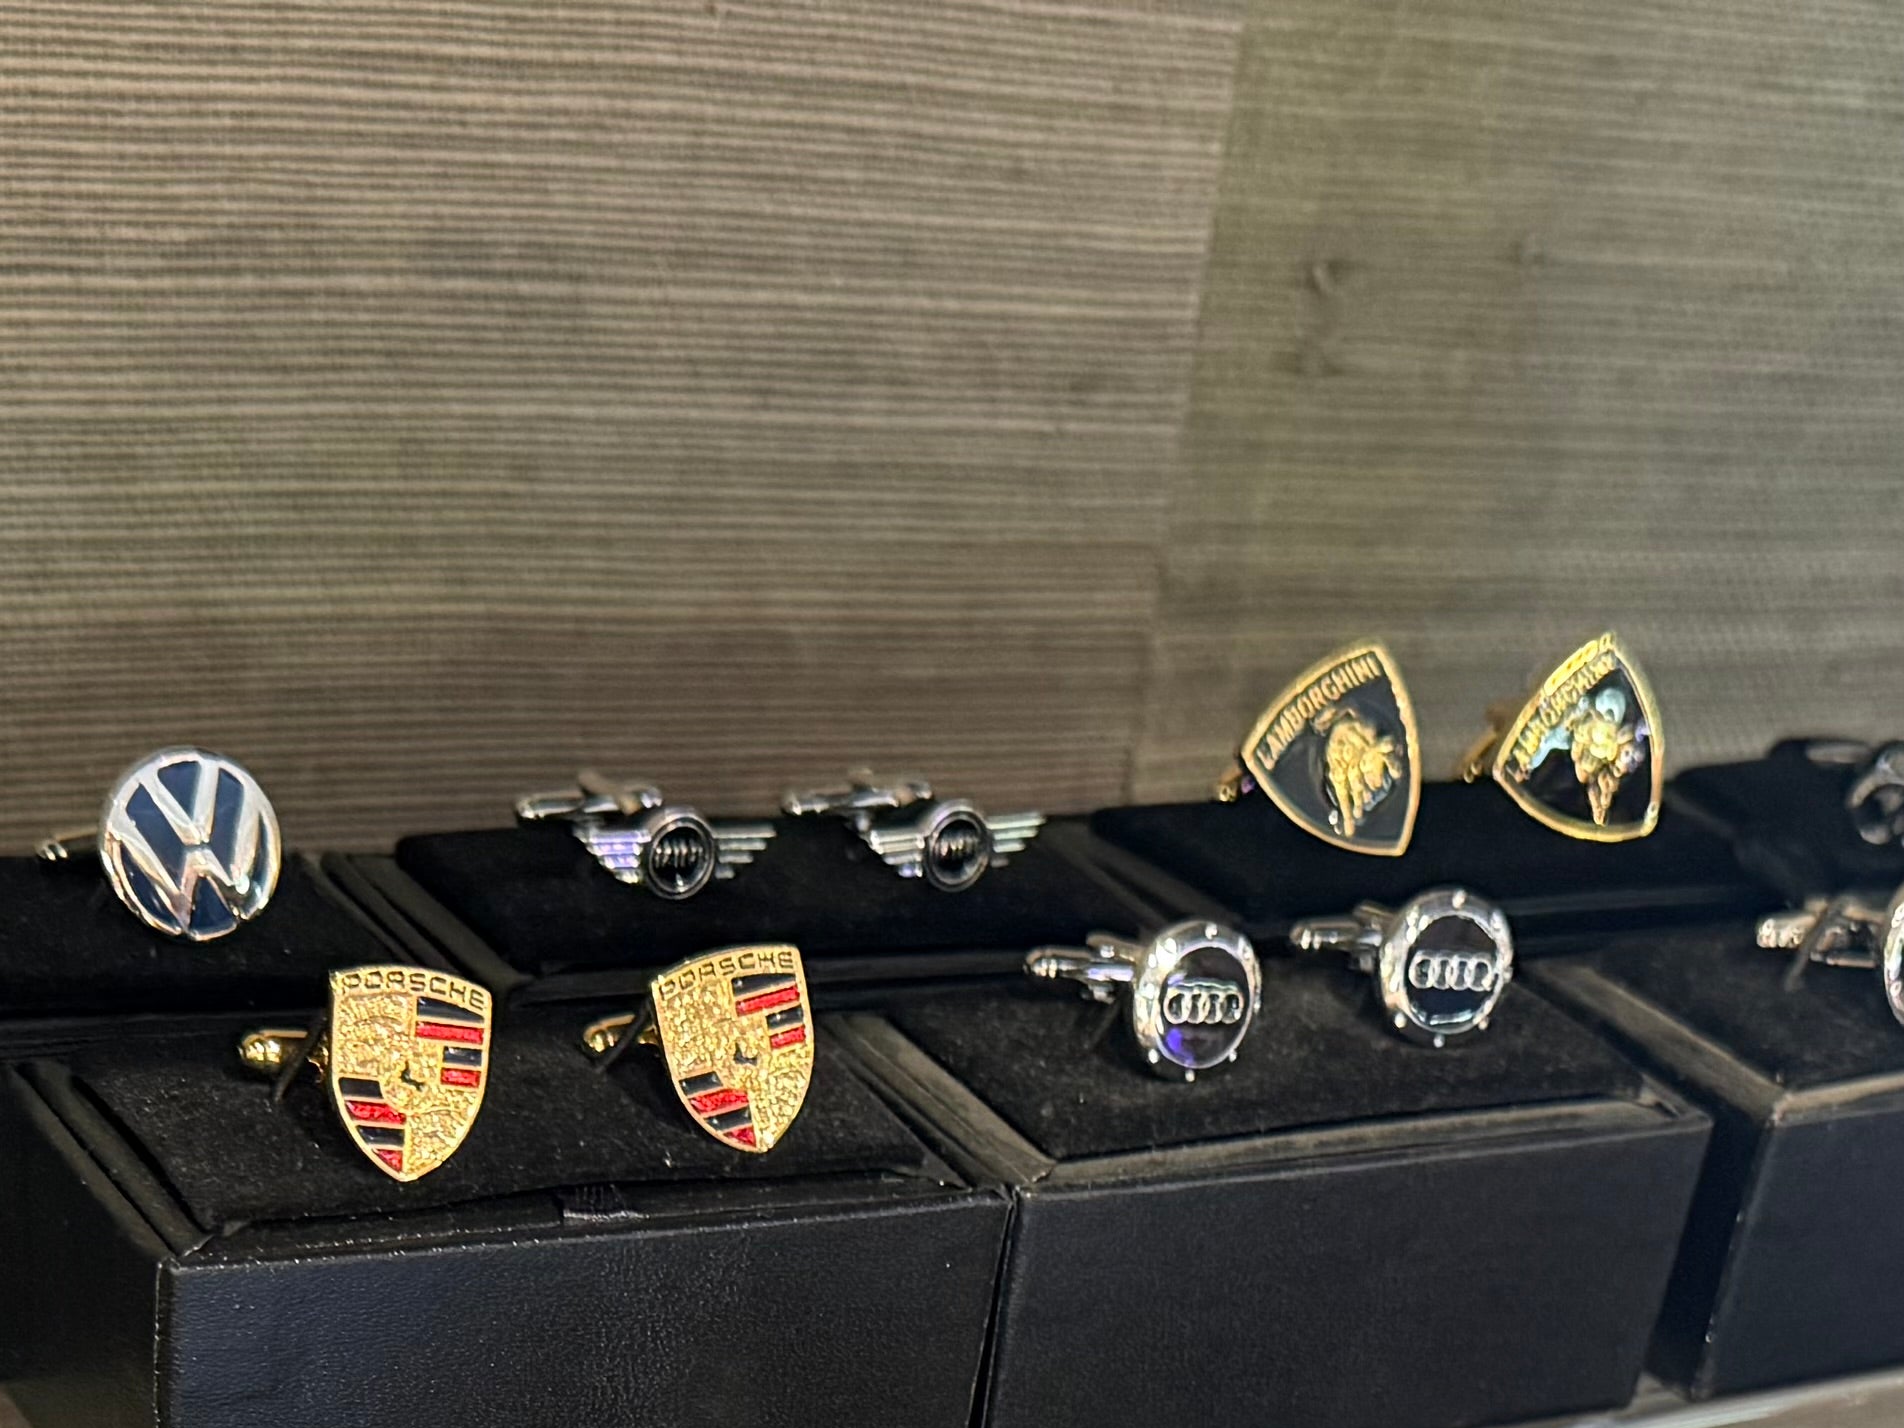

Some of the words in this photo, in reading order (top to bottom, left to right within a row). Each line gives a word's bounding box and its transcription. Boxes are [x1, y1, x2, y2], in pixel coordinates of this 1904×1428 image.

[1254, 652, 1382, 773] LAMBORGHINI
[342, 970, 486, 1009] PORSCHE
[658, 950, 795, 1001] PORSCHE
